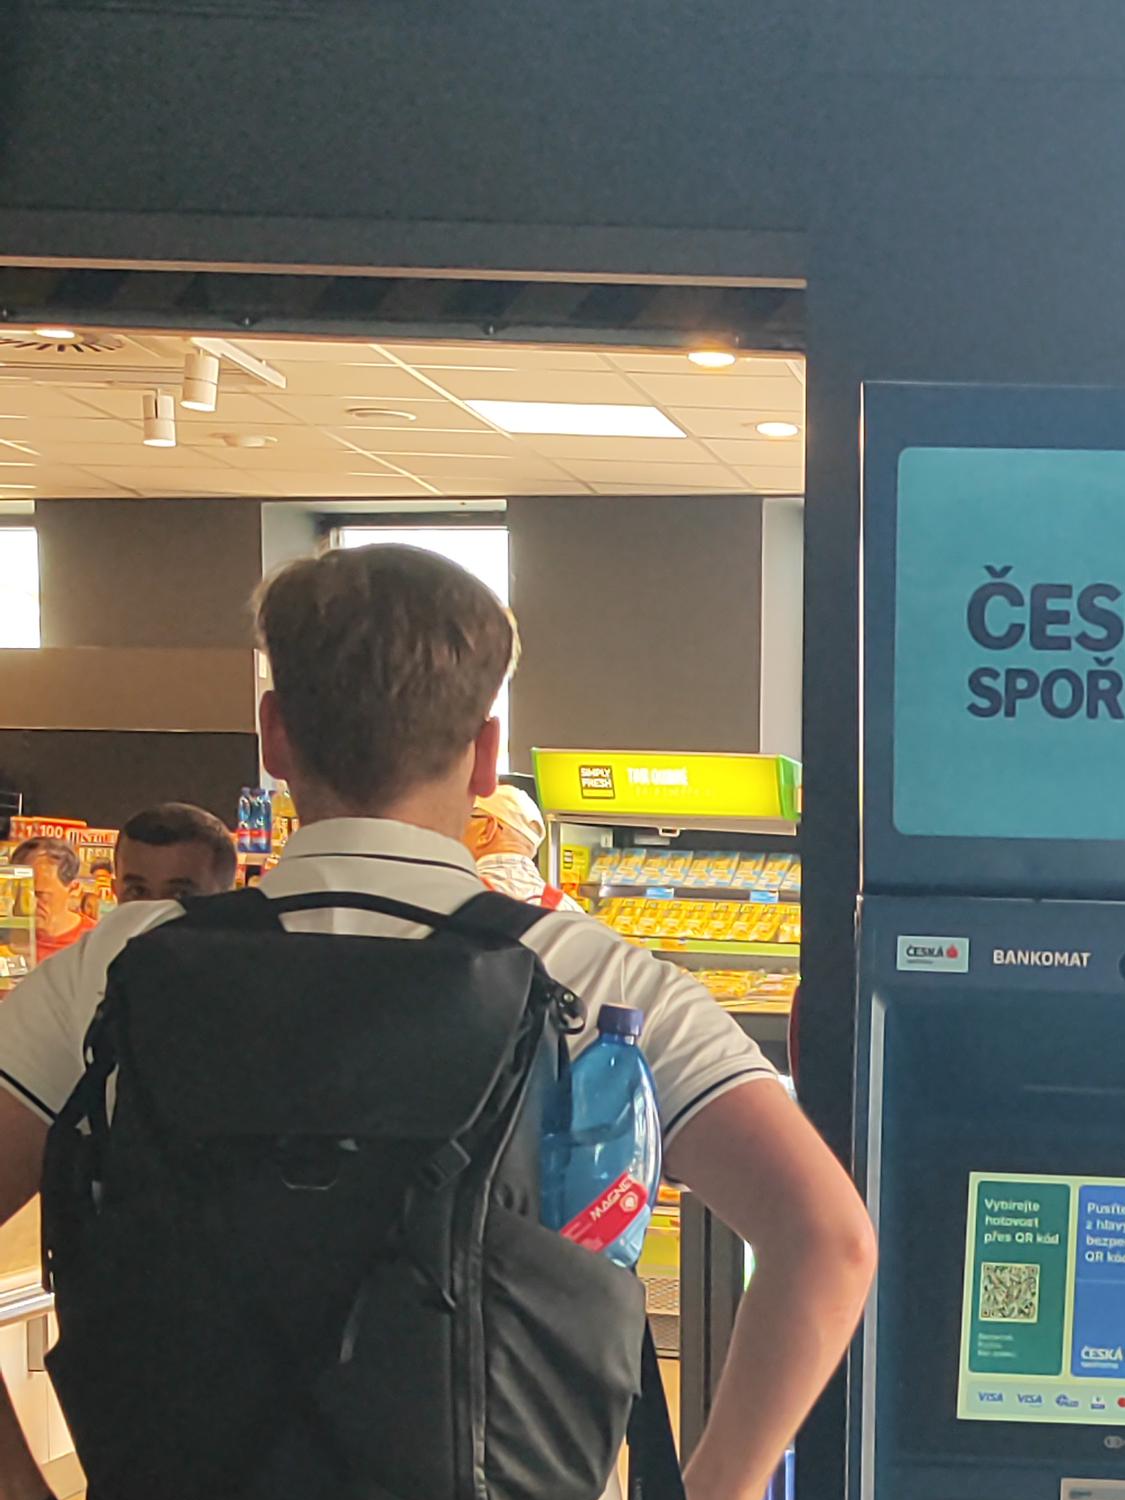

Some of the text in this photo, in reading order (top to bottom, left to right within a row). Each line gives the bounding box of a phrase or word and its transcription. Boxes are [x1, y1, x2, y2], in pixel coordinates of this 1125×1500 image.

[580, 767, 611, 777] SIMPLY
[581, 778, 613, 788] FRESH
[992, 948, 1092, 968] BANKOMAT
[1015, 1232, 1033, 1244] QR
[1036, 1232, 1060, 1245] kód
[1084, 1251, 1103, 1263] QR
[1081, 1344, 1123, 1361] ČESKÁ
[978, 1391, 1004, 1402] VISA
[1017, 1393, 1043, 1404] VISA
